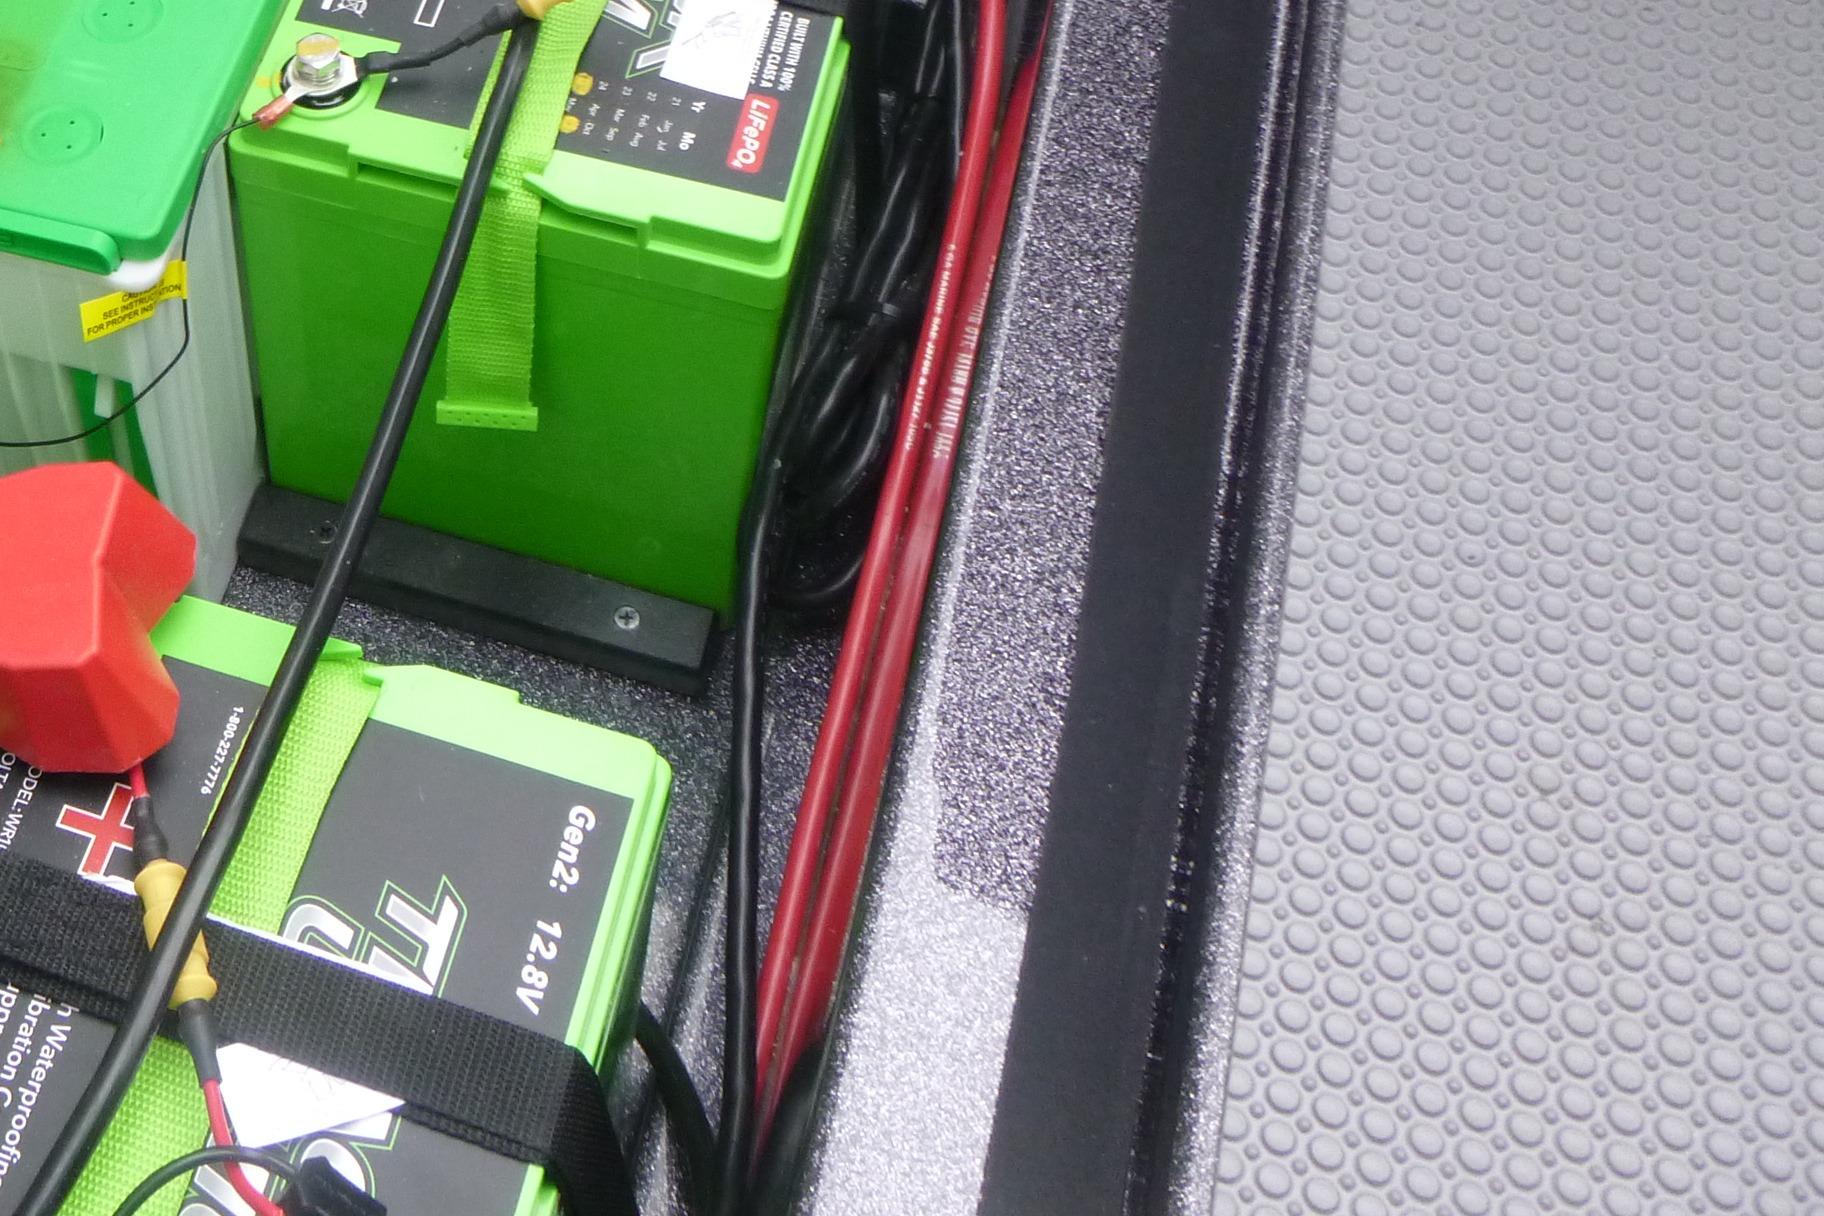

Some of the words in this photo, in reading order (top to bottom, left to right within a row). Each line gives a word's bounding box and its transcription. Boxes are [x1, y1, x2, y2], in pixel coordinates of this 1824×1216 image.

[771, 12, 793, 53] CERTIFIED
[793, 18, 809, 42] BUILT
[786, 43, 803, 65] WITH
[762, 54, 780, 80] CLASS
[598, 80, 608, 90] 24
[778, 68, 796, 90] 100%
[621, 86, 632, 96] 23
[646, 91, 657, 102] 22
[589, 104, 600, 116] Apr
[690, 100, 706, 113] Yr
[614, 109, 625, 122] Mar
[638, 114, 650, 128] Feb
[582, 122, 594, 136] Oct
[604, 126, 618, 141] Sep
[630, 132, 643, 147] Aug
[679, 132, 696, 150] Mo
[103, 308, 118, 319] SEE
[87, 323, 104, 336] FOR
[106, 309, 139, 328] PROPER
[201, 707, 243, 794] 1-800-227-7776
[550, 806, 595, 891] Gen2:
[517, 922, 561, 1014] 12.8V
